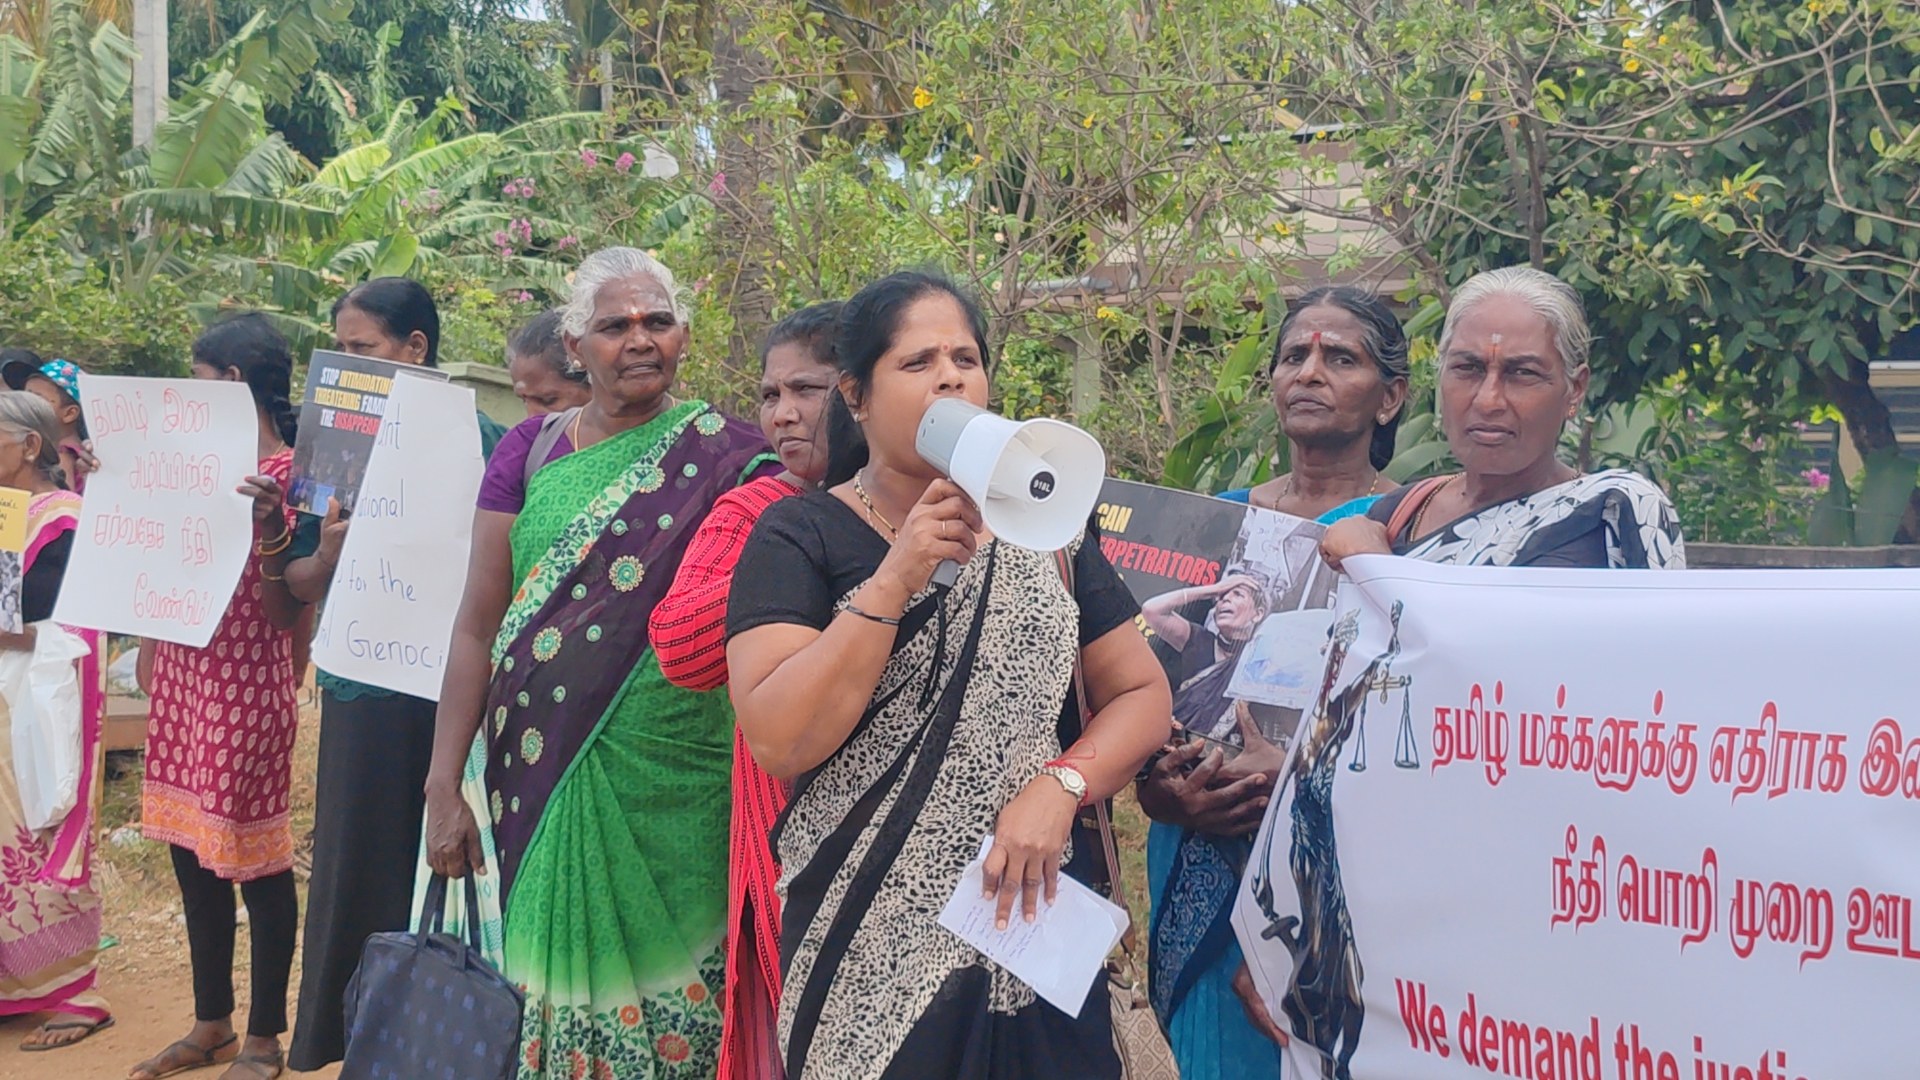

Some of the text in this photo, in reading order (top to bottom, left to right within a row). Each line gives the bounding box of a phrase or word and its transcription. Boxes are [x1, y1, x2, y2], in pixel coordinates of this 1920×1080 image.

[314, 387, 361, 411] THREATENING
[320, 367, 394, 395] STOP INTIMIDATIN
[91, 387, 209, 446] தமிழ் இன
[320, 409, 381, 436] THE DISAPPEAR
[181, 516, 213, 567] நீதி
[1097, 502, 1133, 534] CAN
[379, 557, 417, 602] the
[346, 619, 443, 669] Genoci
[1431, 679, 1510, 787] தமிழ்
[1519, 684, 1698, 795] மக்களுக்கு
[1709, 700, 1848, 807] எதிராக
[1550, 823, 1607, 935] நீதி
[1616, 847, 1719, 957] பொறி
[1729, 878, 1834, 974] முறை
[1394, 977, 1451, 1059] We
[1457, 992, 1604, 1080] demand
[1613, 1022, 1682, 1080] the
